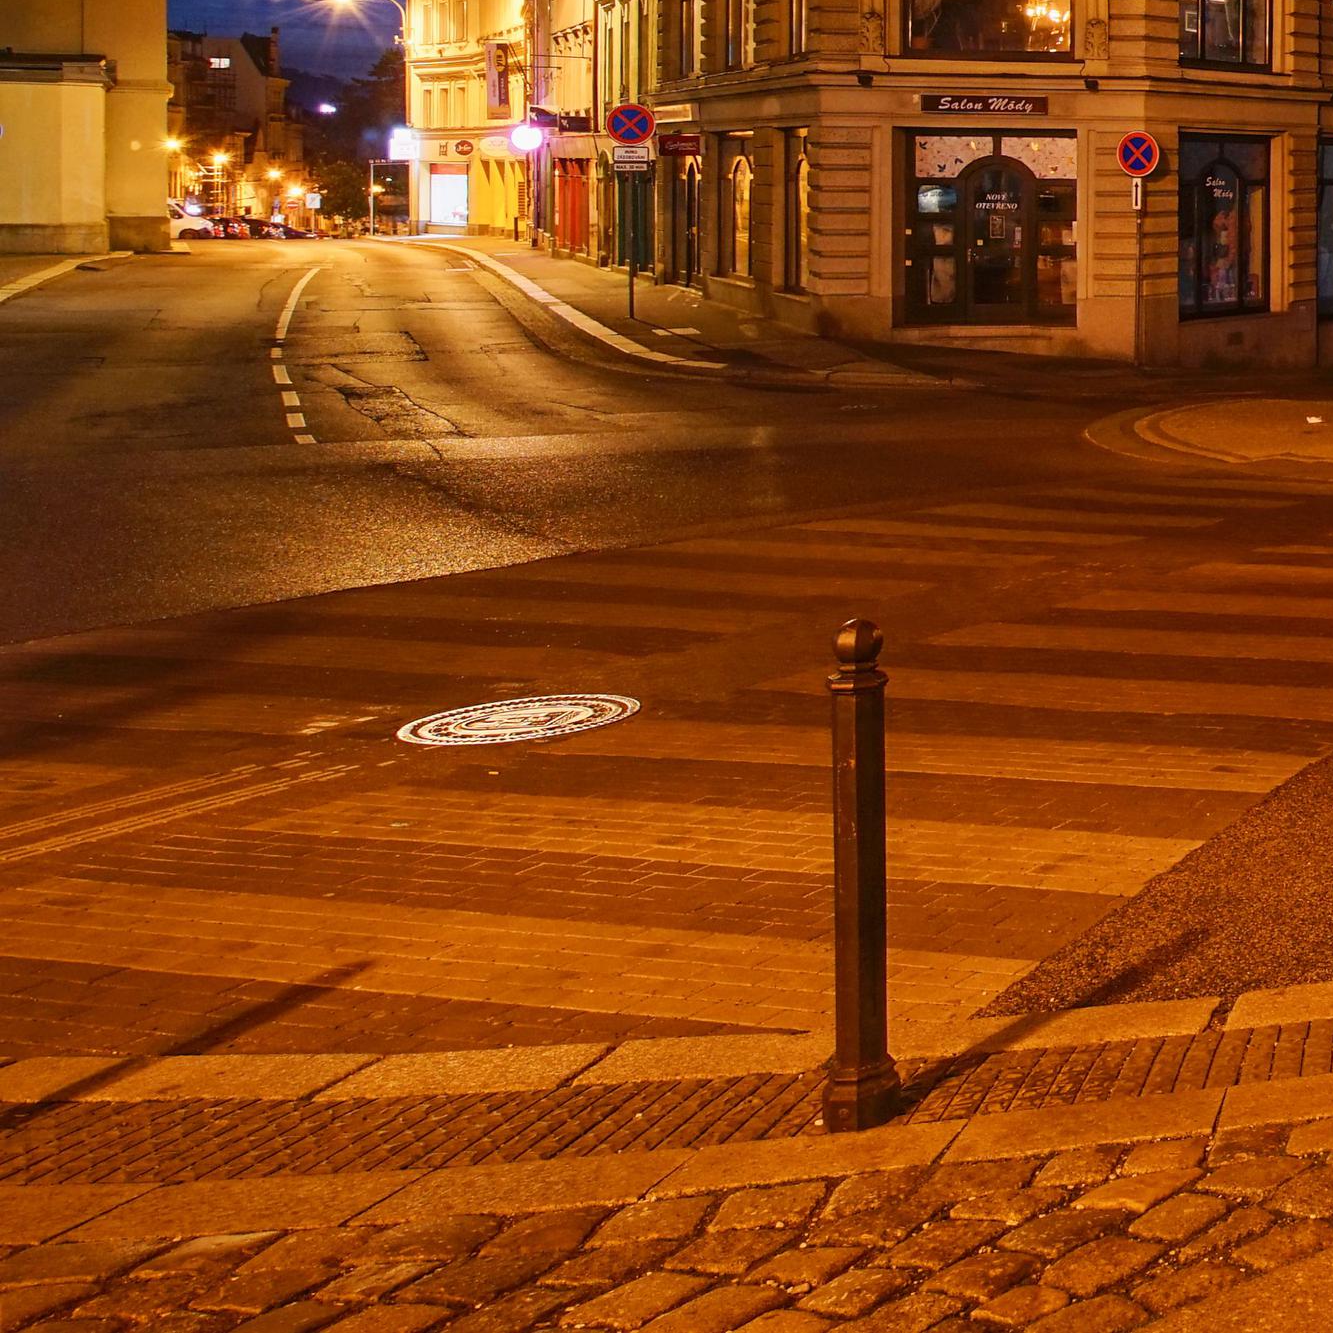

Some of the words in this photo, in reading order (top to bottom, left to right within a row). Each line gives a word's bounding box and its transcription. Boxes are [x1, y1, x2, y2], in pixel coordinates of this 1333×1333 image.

[938, 97, 983, 111] Salon
[988, 98, 1033, 114] Módy
[1205, 176, 1226, 187] Salon
